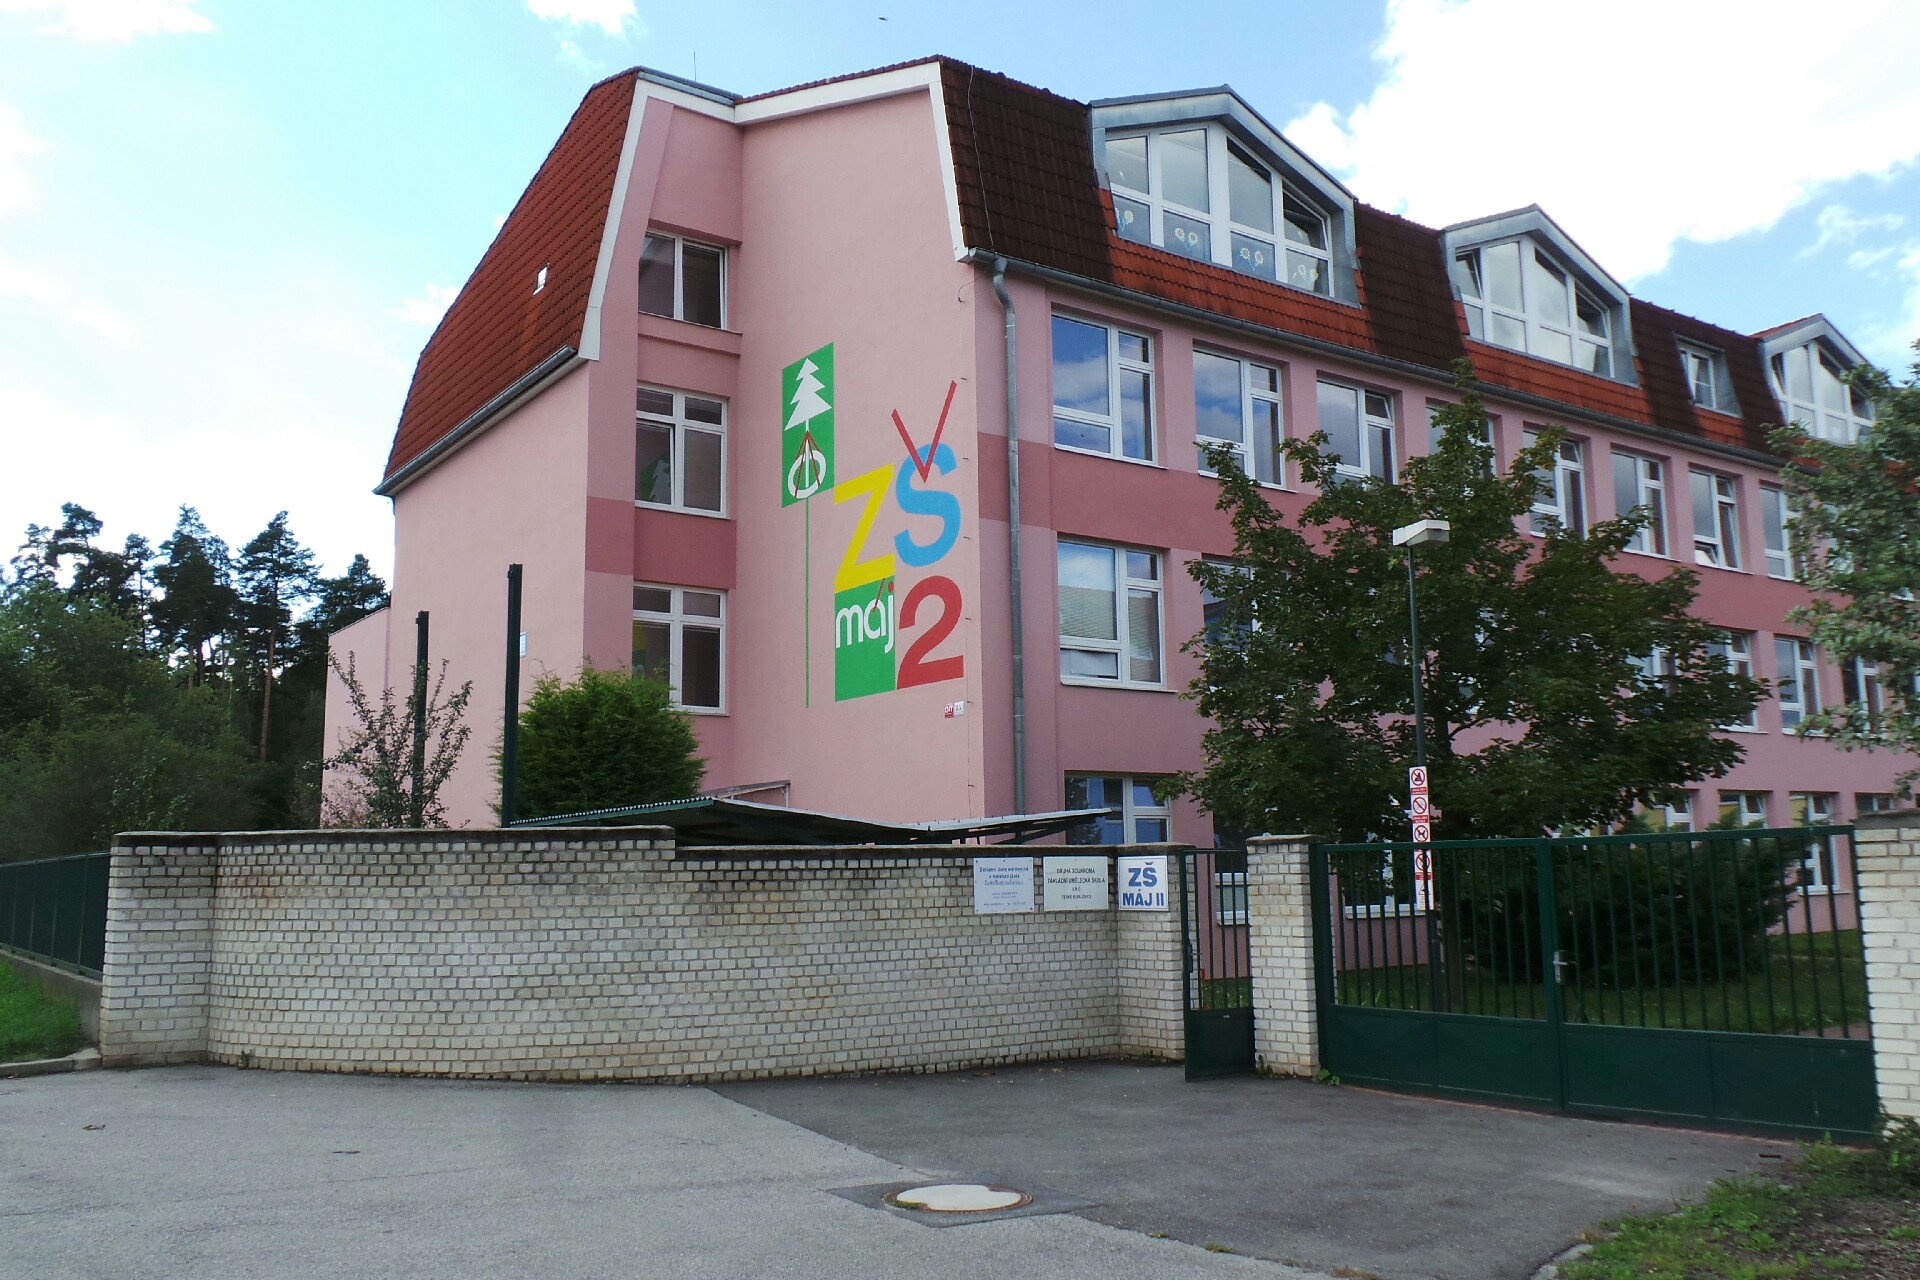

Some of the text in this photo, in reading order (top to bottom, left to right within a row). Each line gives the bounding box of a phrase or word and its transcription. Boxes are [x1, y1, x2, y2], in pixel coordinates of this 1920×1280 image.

[834, 380, 961, 593] ZŠ
[896, 575, 964, 690] 2
[1123, 889, 1164, 906] MÁJ II
[1128, 861, 1157, 887] ZŠ
